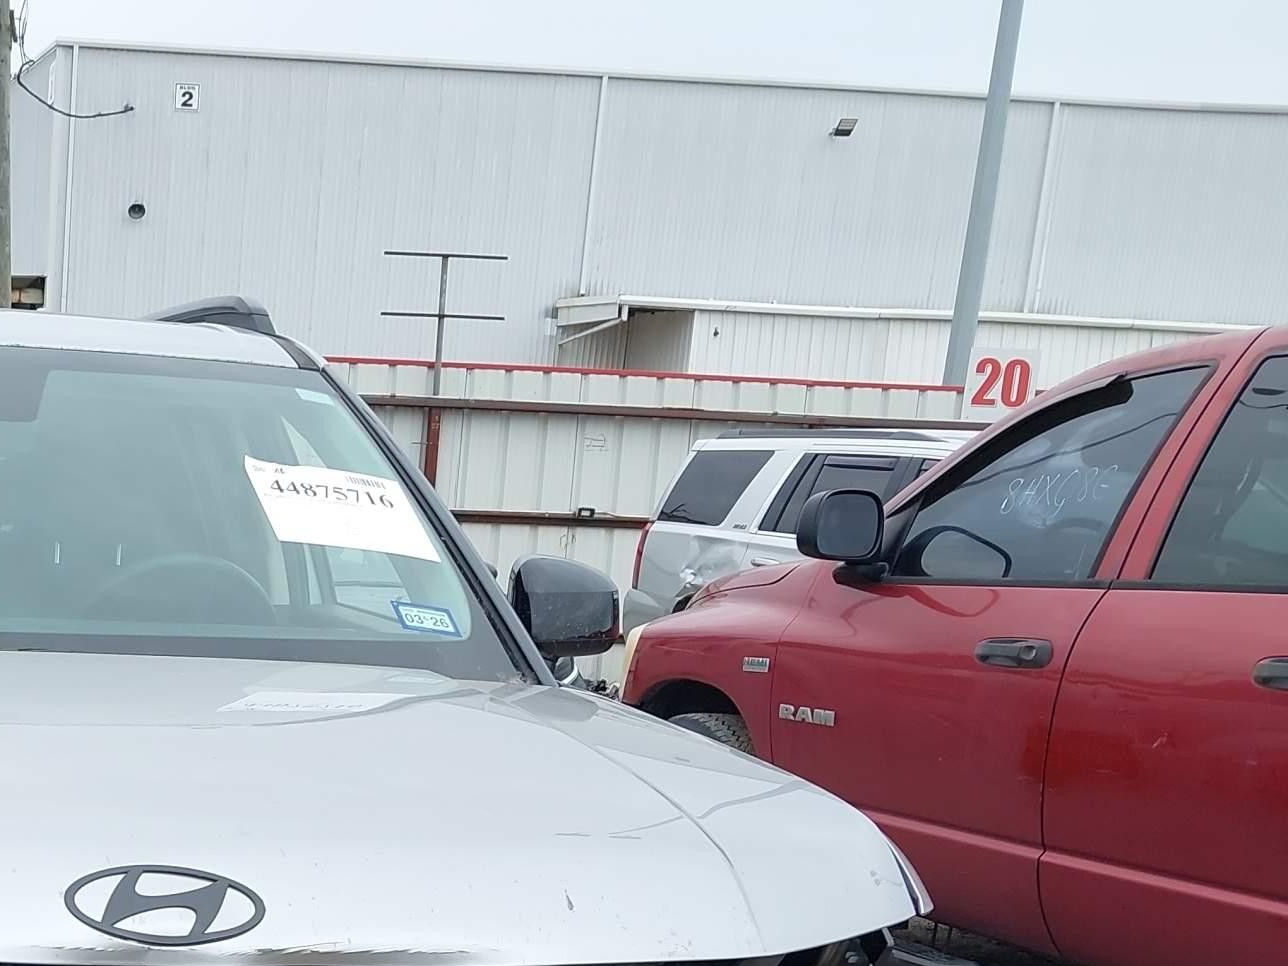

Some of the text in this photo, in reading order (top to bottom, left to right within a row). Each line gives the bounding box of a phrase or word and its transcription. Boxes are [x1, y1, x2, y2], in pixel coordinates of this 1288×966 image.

[181, 91, 193, 107] 2
[971, 358, 1030, 407] 20
[270, 479, 394, 508] 44875716
[779, 704, 835, 727] RAM
